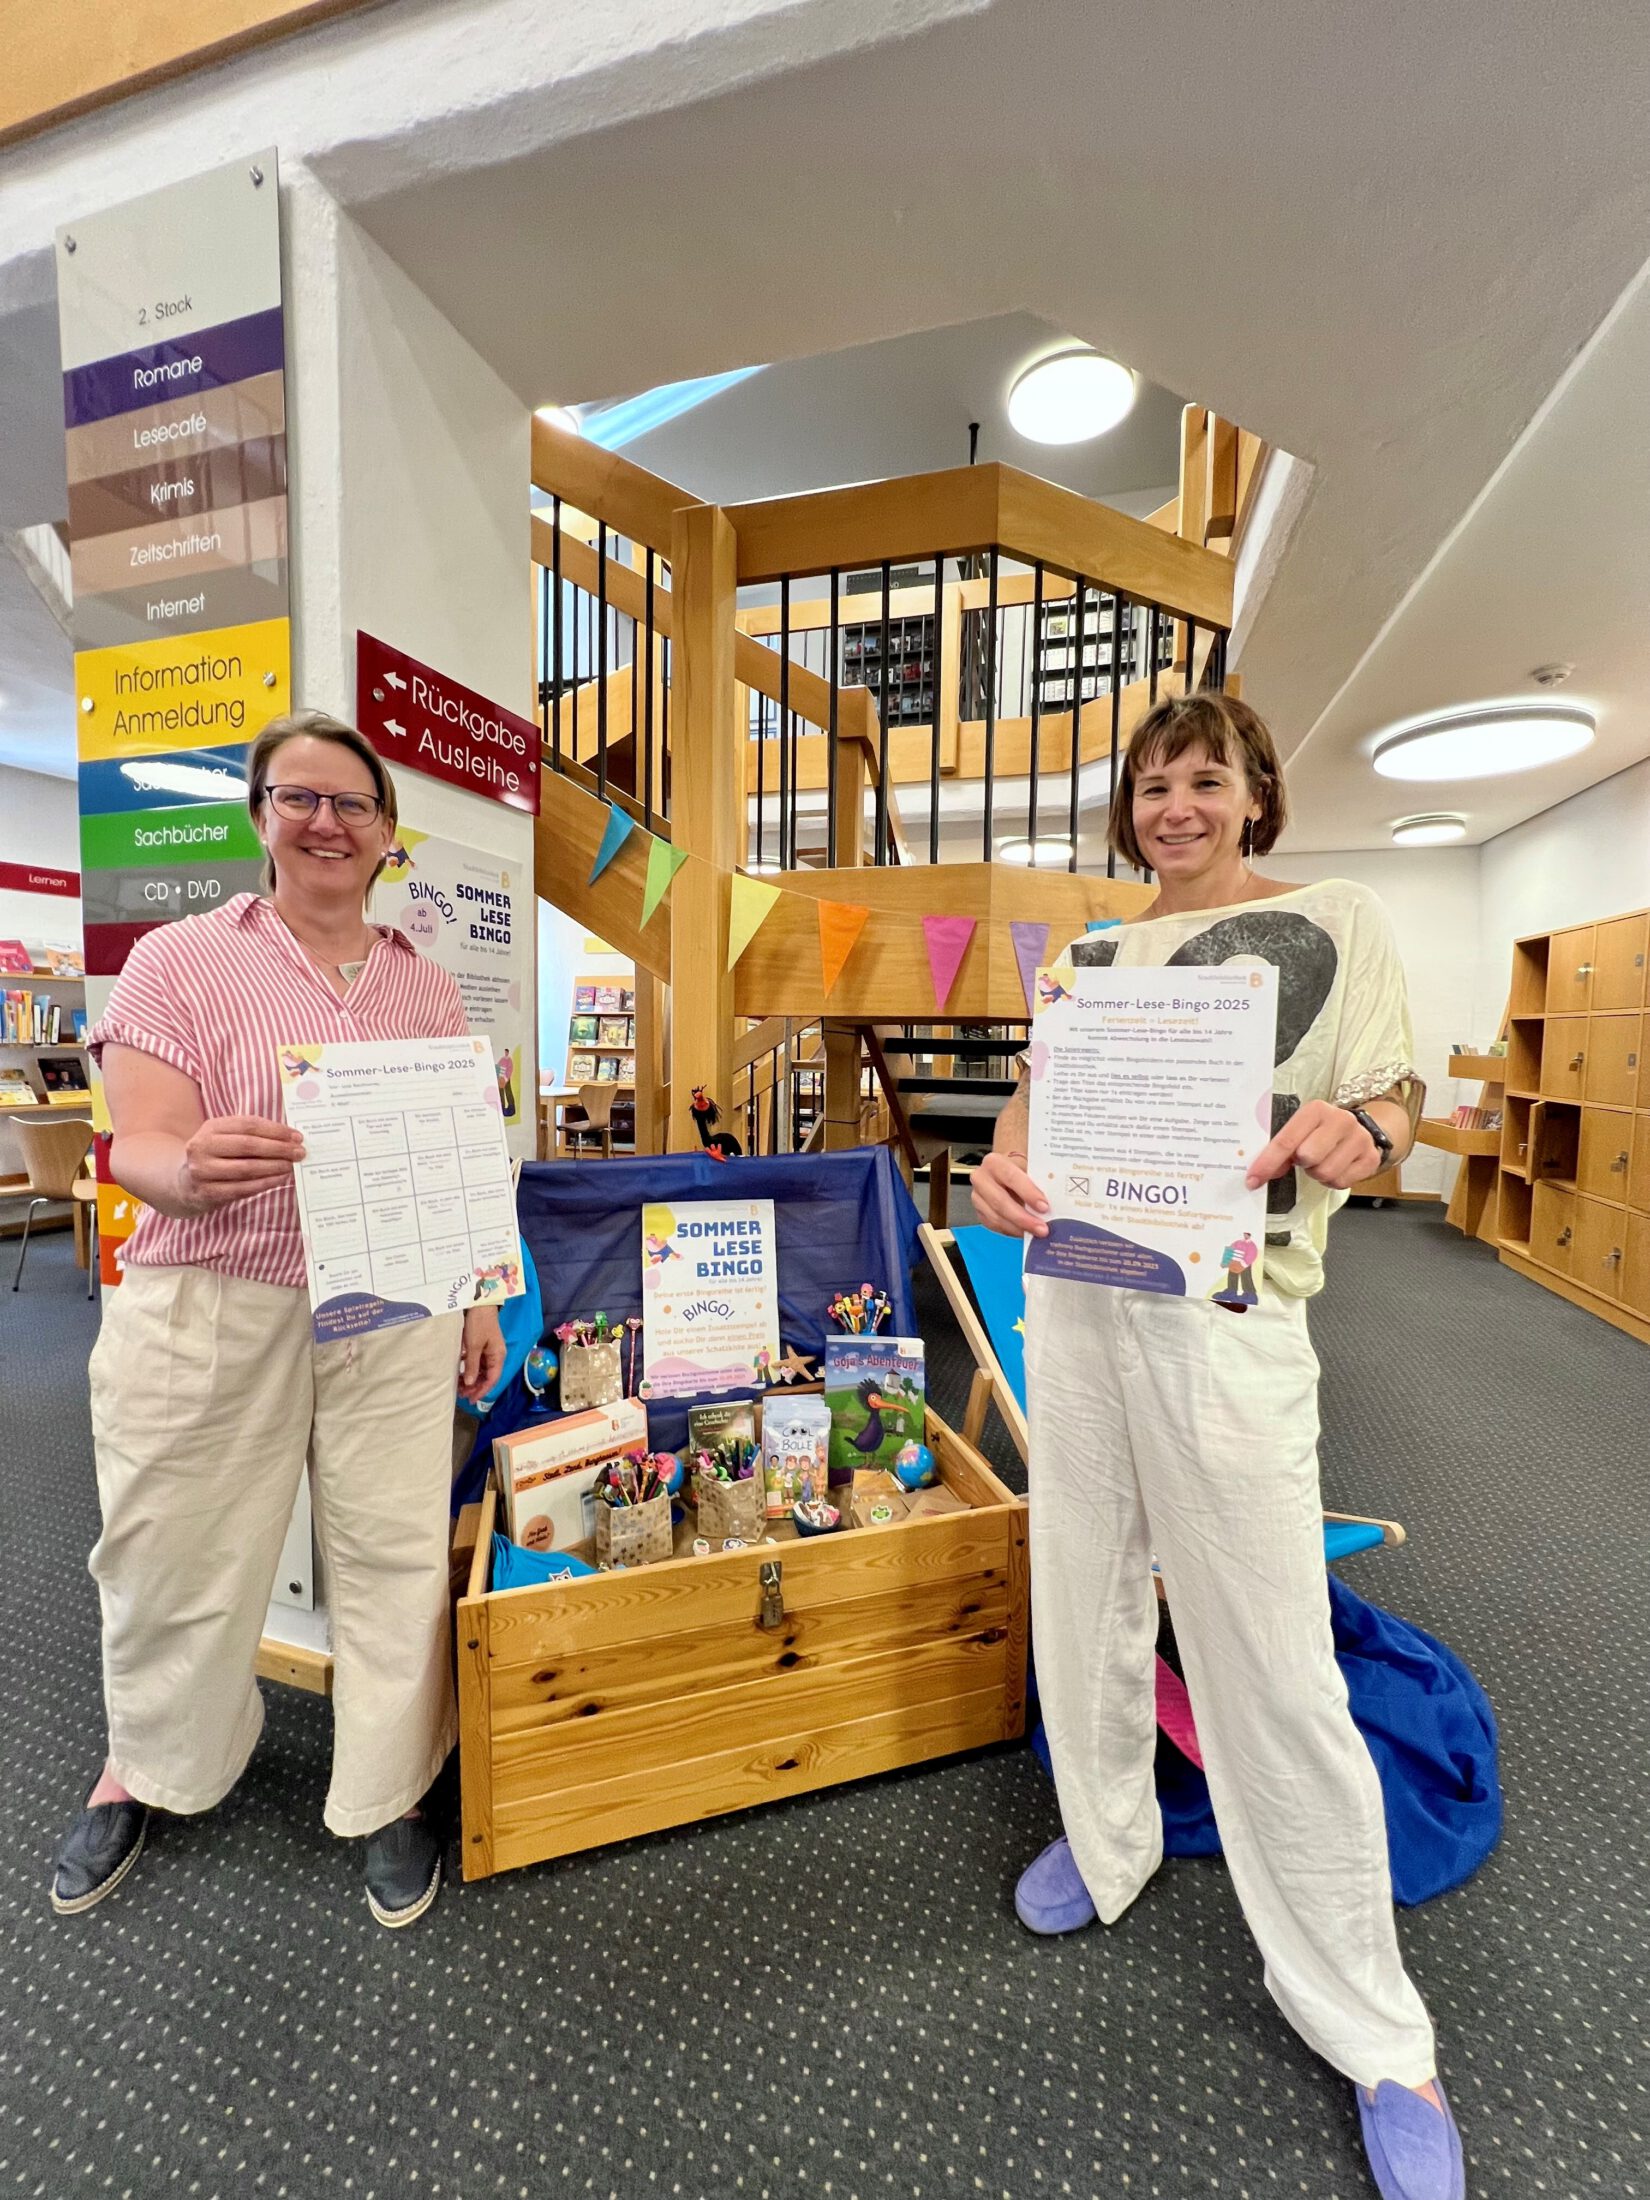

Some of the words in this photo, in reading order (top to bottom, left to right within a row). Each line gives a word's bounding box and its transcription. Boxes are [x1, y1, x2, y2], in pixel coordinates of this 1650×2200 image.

[138, 309, 150, 326] 2.
[155, 295, 193, 320] Stock
[134, 356, 203, 390] Romane
[133, 411, 207, 449] Lesecafé
[150, 477, 195, 504] Krimis
[130, 533, 221, 566] Zeitschriften
[147, 593, 205, 620] Internet
[115, 655, 242, 695] Information
[113, 699, 245, 736] Anmeldung
[413, 675, 526, 756] Rückgabe
[418, 728, 520, 792] Ausleihe
[134, 823, 229, 847] Sachbücher
[28, 873, 67, 887] Lernen
[144, 882, 168, 901] CD
[188, 879, 221, 899] DVD
[408, 881, 458, 925] BINGO!
[456, 883, 511, 910] SOMMER
[417, 908, 427, 918] ab
[480, 908, 511, 927] LESE
[470, 924, 511, 944] BINGO
[1077, 998, 1210, 1013] Sommer-Lese-Bingo
[1213, 999, 1250, 1011] 2025
[326, 1060, 446, 1078] Sommer-Lese-Bingo
[448, 1060, 476, 1070] 2025
[1106, 1178, 1188, 1205] BINGO!
[677, 1221, 761, 1238] SOMMER
[713, 1240, 762, 1256] LESE
[696, 1259, 762, 1277] BINGO
[447, 1273, 472, 1309] BINGO!
[682, 1300, 735, 1322] BINGO!
[867, 1354, 919, 1371] Abenteuer
[782, 1439, 812, 1451] BOLLE
